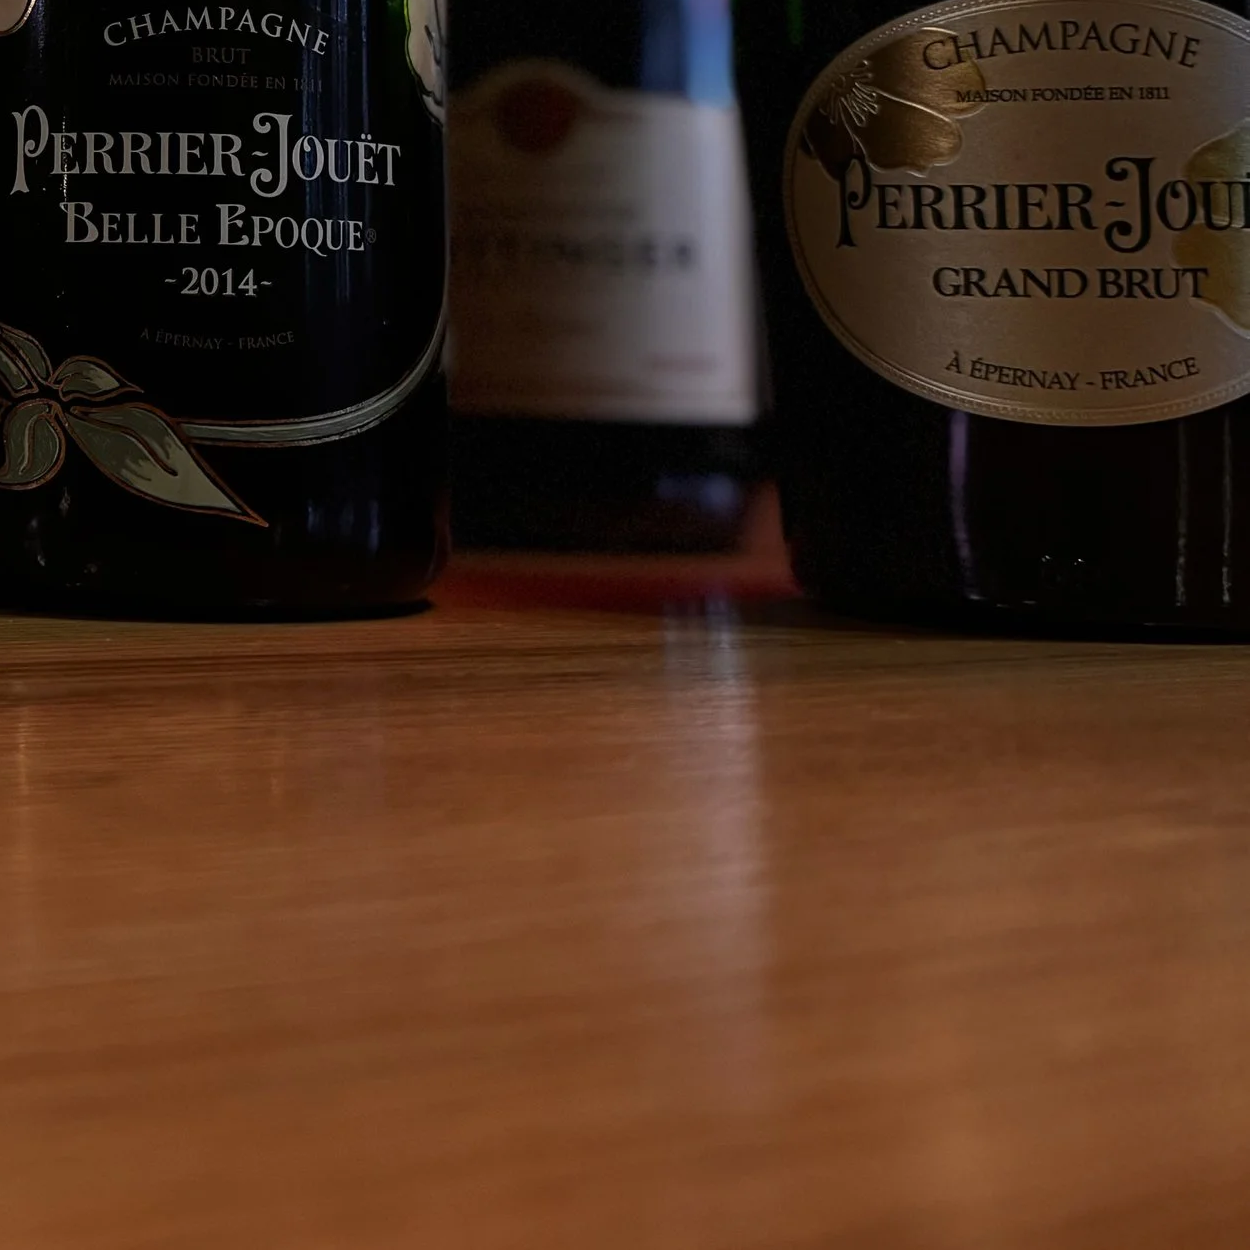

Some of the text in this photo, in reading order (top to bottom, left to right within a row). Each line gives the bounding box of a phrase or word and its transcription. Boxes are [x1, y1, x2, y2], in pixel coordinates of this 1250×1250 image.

[103, 6, 329, 56] CHAMPAGNE
[922, 21, 1200, 70] CHAMPAGNE
[191, 46, 251, 65] BRUT
[109, 72, 180, 87] MAISON
[188, 71, 259, 89] FONDÉE
[265, 76, 286, 90] EN
[956, 85, 1170, 103] MAISON FONDÉE EN 1811
[9, 104, 402, 198] PERRIER-JOUËT
[59, 200, 202, 245] BELLE
[933, 268, 1208, 299] GRAND BRUT
[238, 330, 295, 350] FRANCE
[946, 351, 962, 373] À
[970, 356, 1080, 390] ÉPERNAY
[1100, 357, 1199, 390] FRANCE
